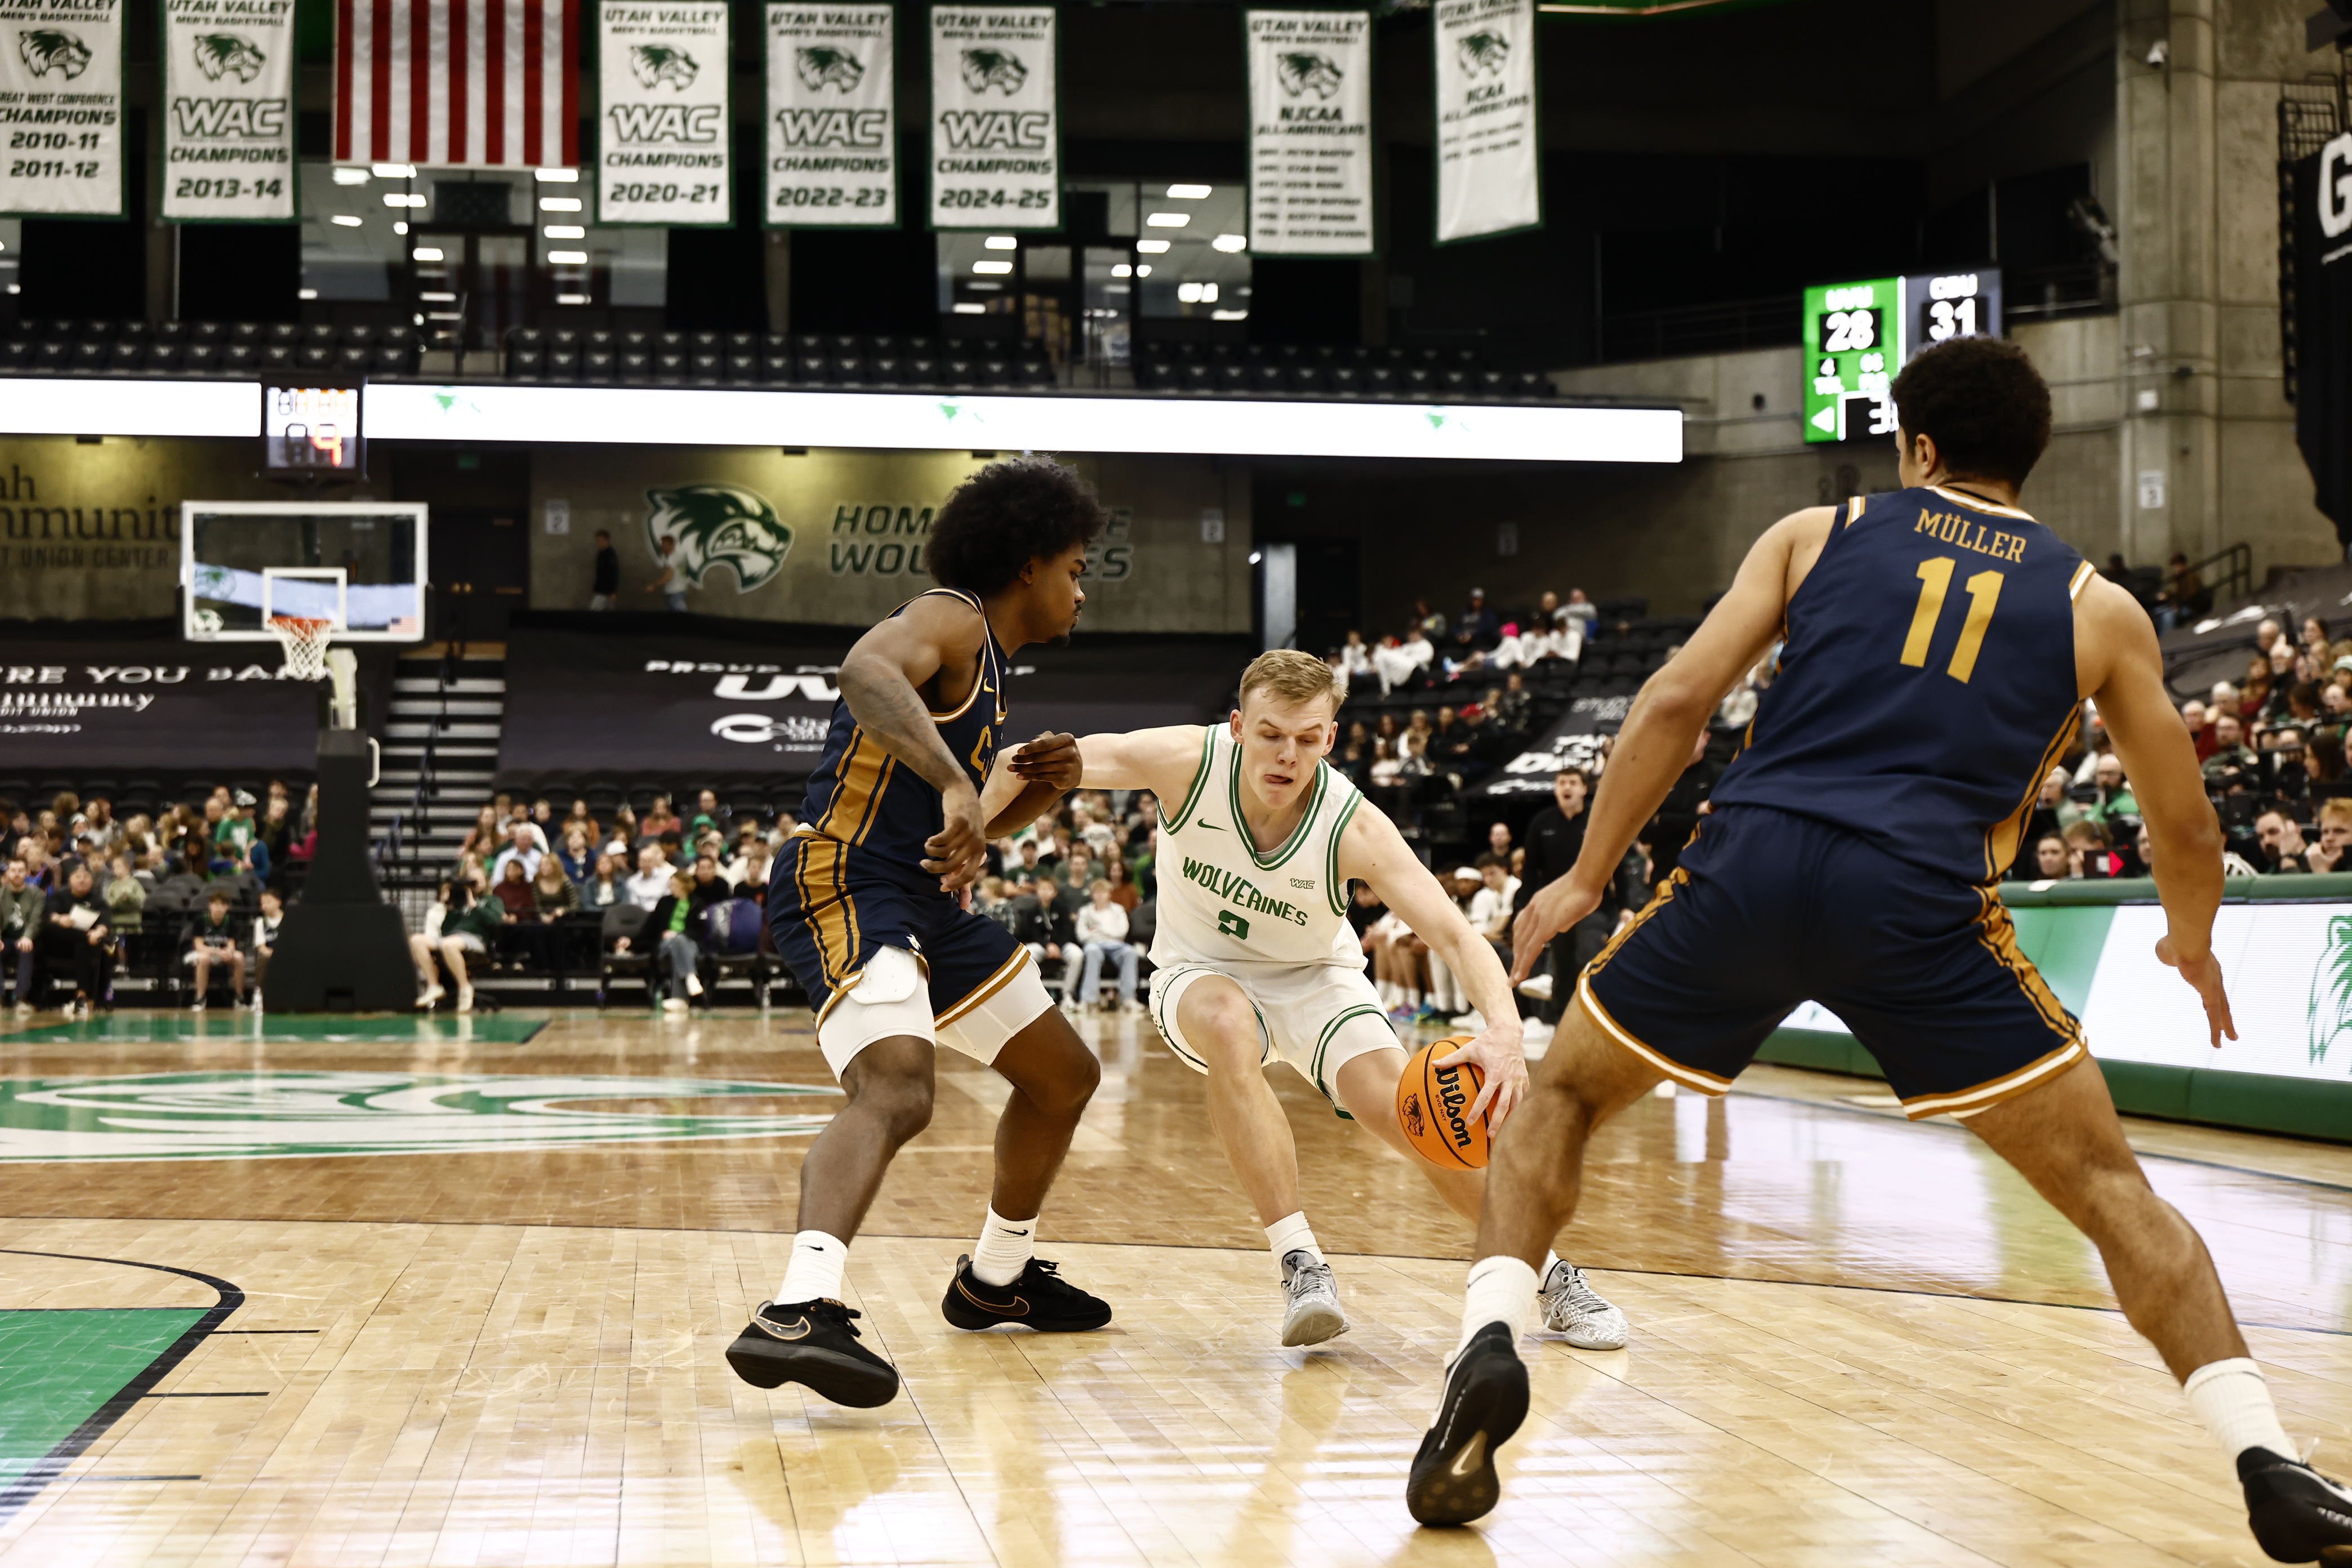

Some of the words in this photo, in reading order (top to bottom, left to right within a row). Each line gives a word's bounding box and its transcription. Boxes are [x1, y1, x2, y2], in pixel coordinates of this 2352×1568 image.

[170, 0, 218, 12] UTAH
[225, 1, 292, 14] VALLEY
[605, 10, 652, 22] UTAH
[660, 10, 723, 23] VALLEY
[770, 12, 818, 25] UTAH
[824, 13, 888, 25] VALLEY
[936, 15, 982, 27] UTAH
[988, 16, 1052, 28] VALLEY
[0, 92, 24, 104] REAT
[173, 97, 287, 137] WAC
[609, 104, 721, 142] WAC
[776, 109, 887, 147] WAC
[941, 110, 1050, 149] WAC
[10, 131, 100, 150] 2010-11
[170, 146, 288, 163] CHAMPIONS
[607, 153, 723, 168] CHAMPIONS
[10, 160, 99, 178] 2011-12
[773, 157, 890, 172] CHAMPIONS
[938, 159, 1052, 174] CHAMPIONS
[176, 177, 283, 198] 2013-14
[611, 182, 720, 203] 2020-21
[776, 187, 888, 207] 2022-23
[939, 188, 1052, 209] 2024-25
[1928, 297, 1976, 341] 31
[1825, 309, 1875, 353] 28
[1914, 507, 2027, 563] MÜLLER
[1900, 556, 2005, 684] 11
[0, 666, 67, 683] RE
[86, 666, 190, 684] YOU
[1183, 857, 1308, 926] WOLVERINES
[1290, 878, 1315, 889] WAC
